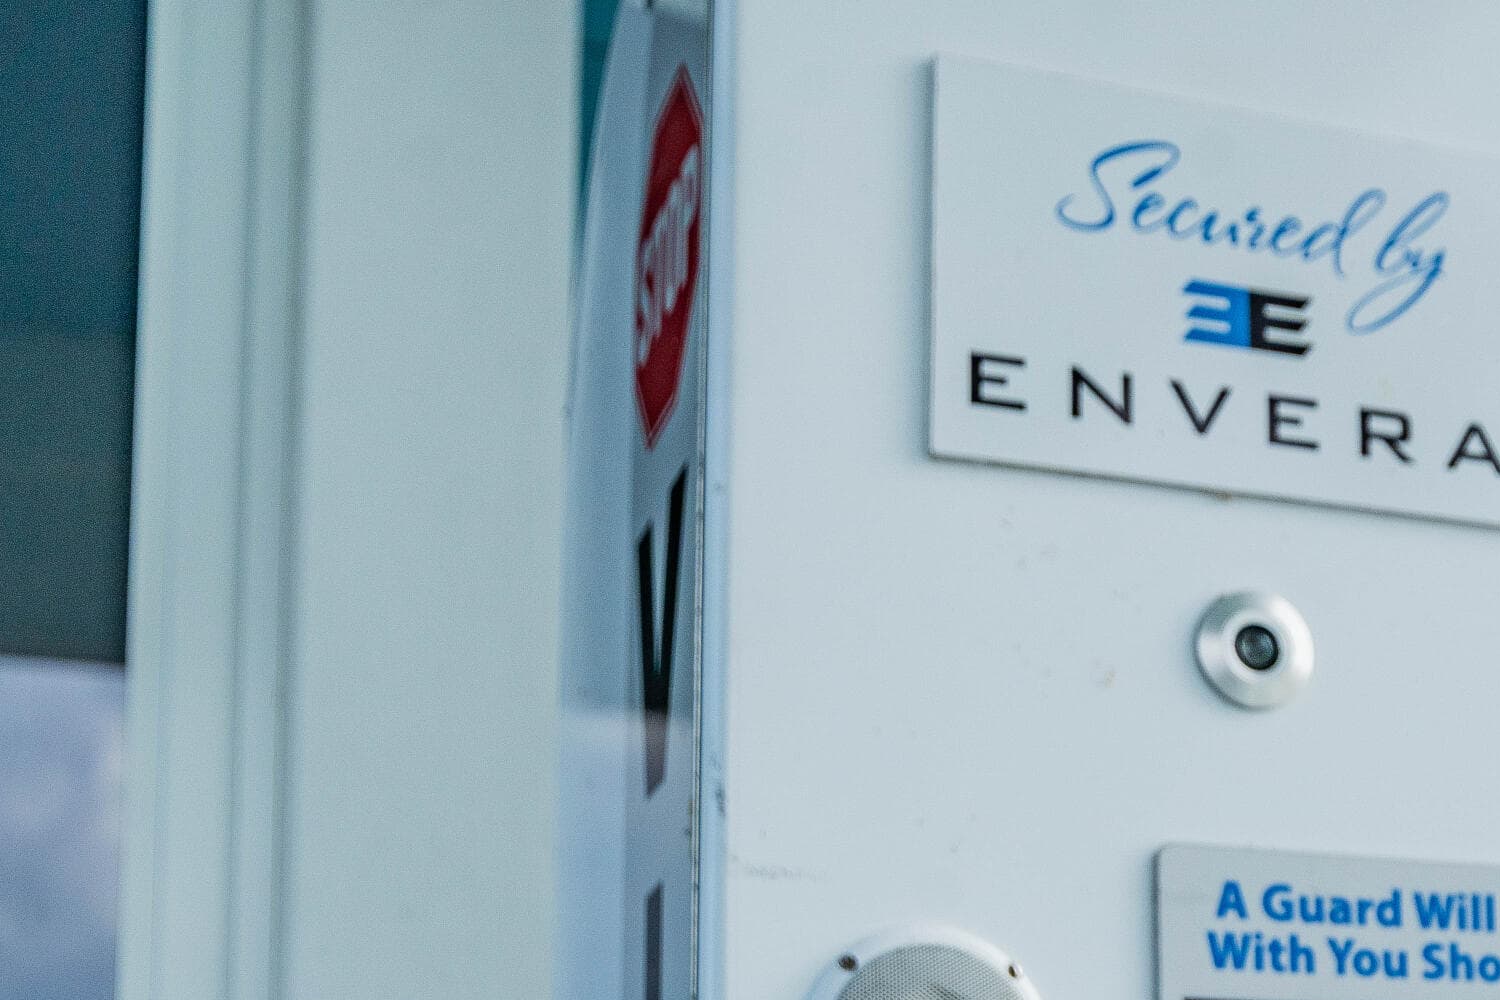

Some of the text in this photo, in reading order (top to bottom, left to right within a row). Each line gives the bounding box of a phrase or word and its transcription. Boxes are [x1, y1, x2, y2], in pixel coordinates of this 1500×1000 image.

[1055, 139, 1450, 335] Secured by
[1216, 879, 1249, 920] A
[1262, 884, 1402, 929] Guard
[1413, 890, 1496, 932] Will
[1206, 930, 1316, 974] With
[1328, 937, 1409, 978] You
